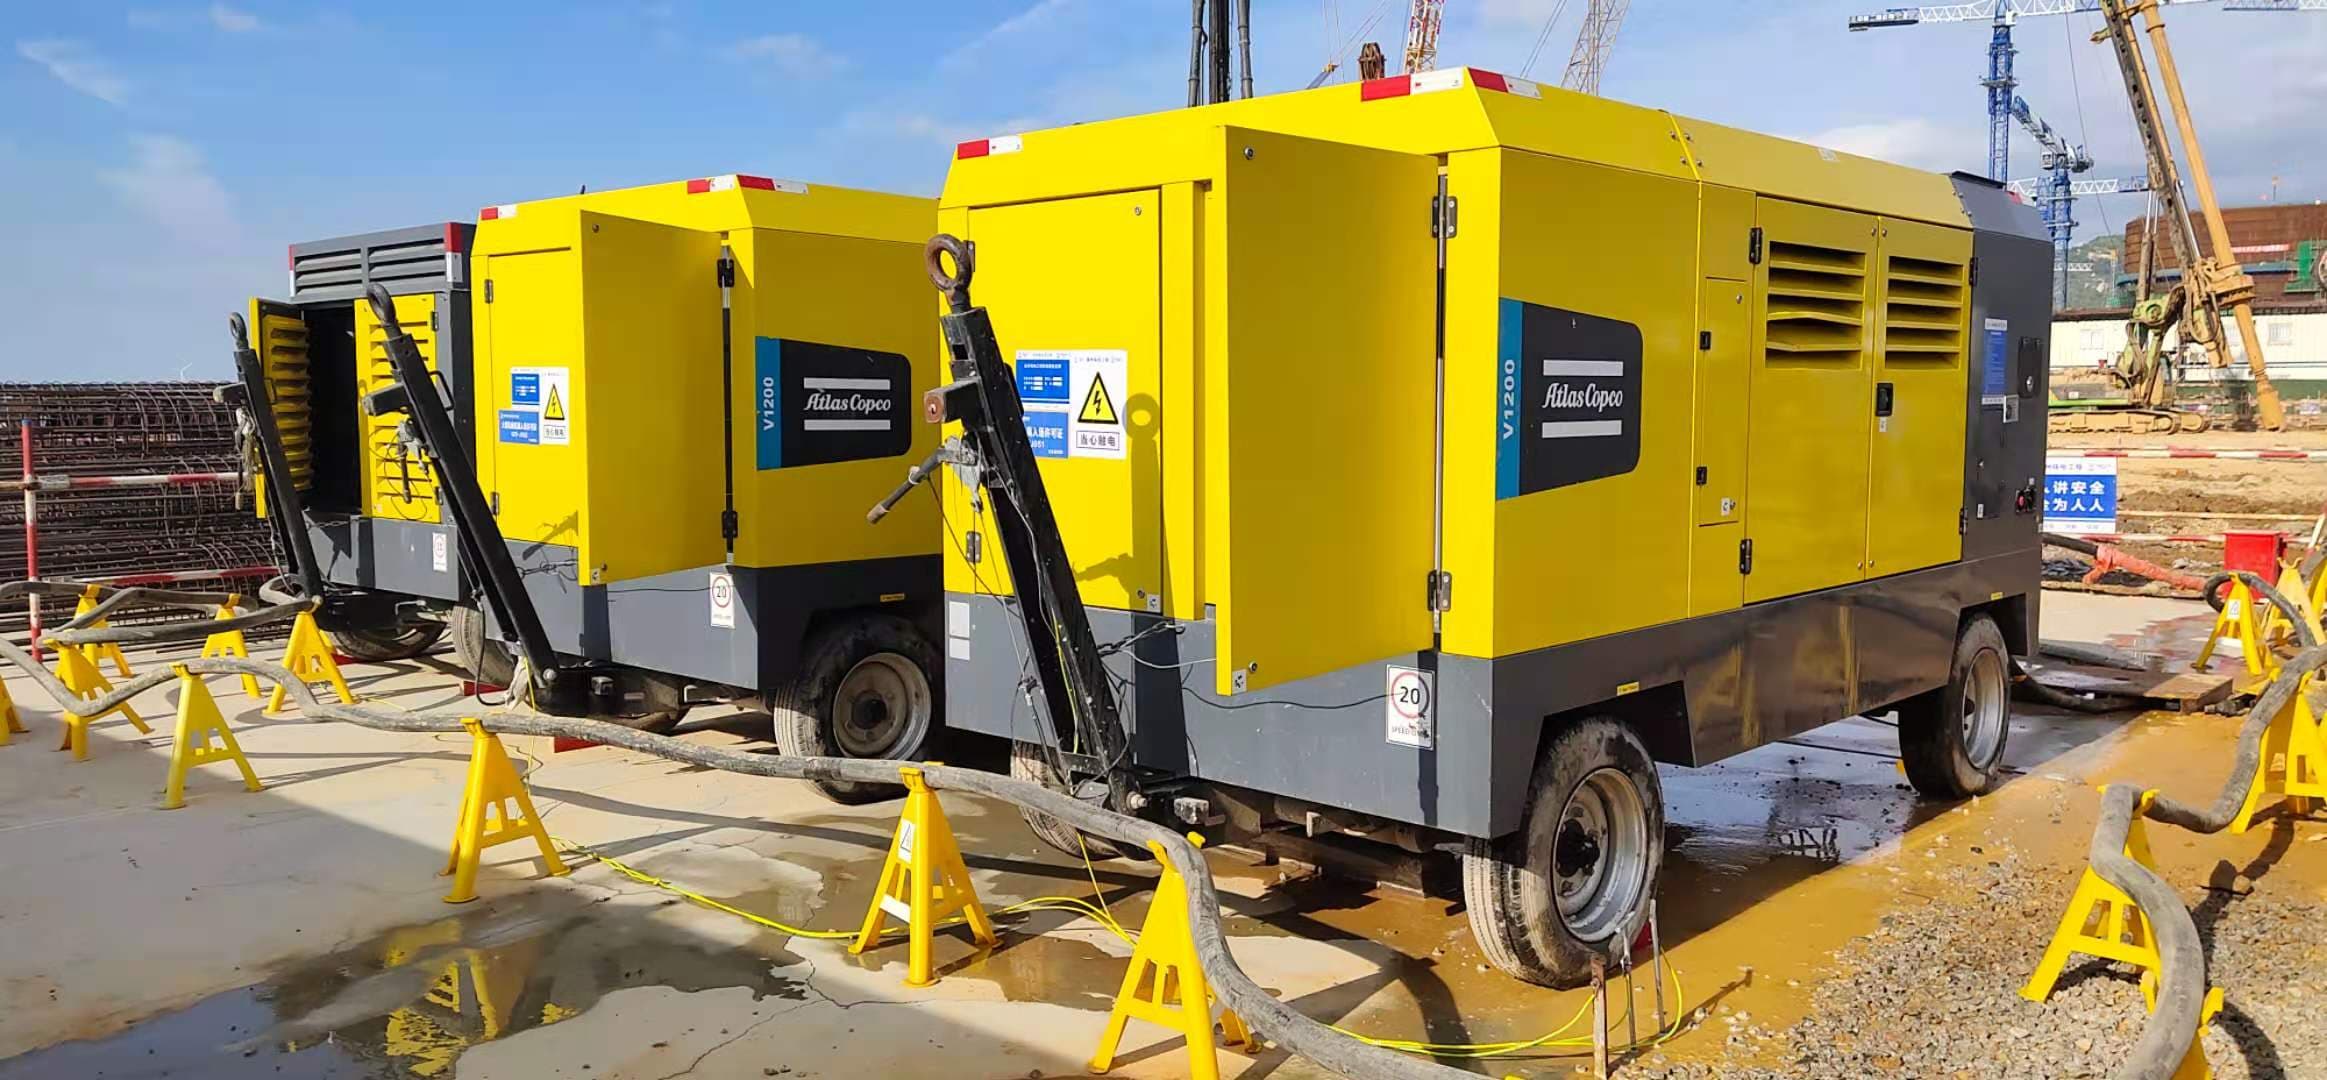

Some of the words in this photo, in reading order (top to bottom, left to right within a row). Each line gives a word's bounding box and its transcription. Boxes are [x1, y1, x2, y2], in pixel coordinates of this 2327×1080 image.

[762, 376, 775, 431] V1200
[804, 392, 849, 412] Atlas
[850, 393, 891, 416] Copco
[1503, 359, 1516, 441] V1200
[1542, 382, 1585, 409] Atlas
[1585, 383, 1623, 413] Copco
[1399, 685, 1421, 705] 20
